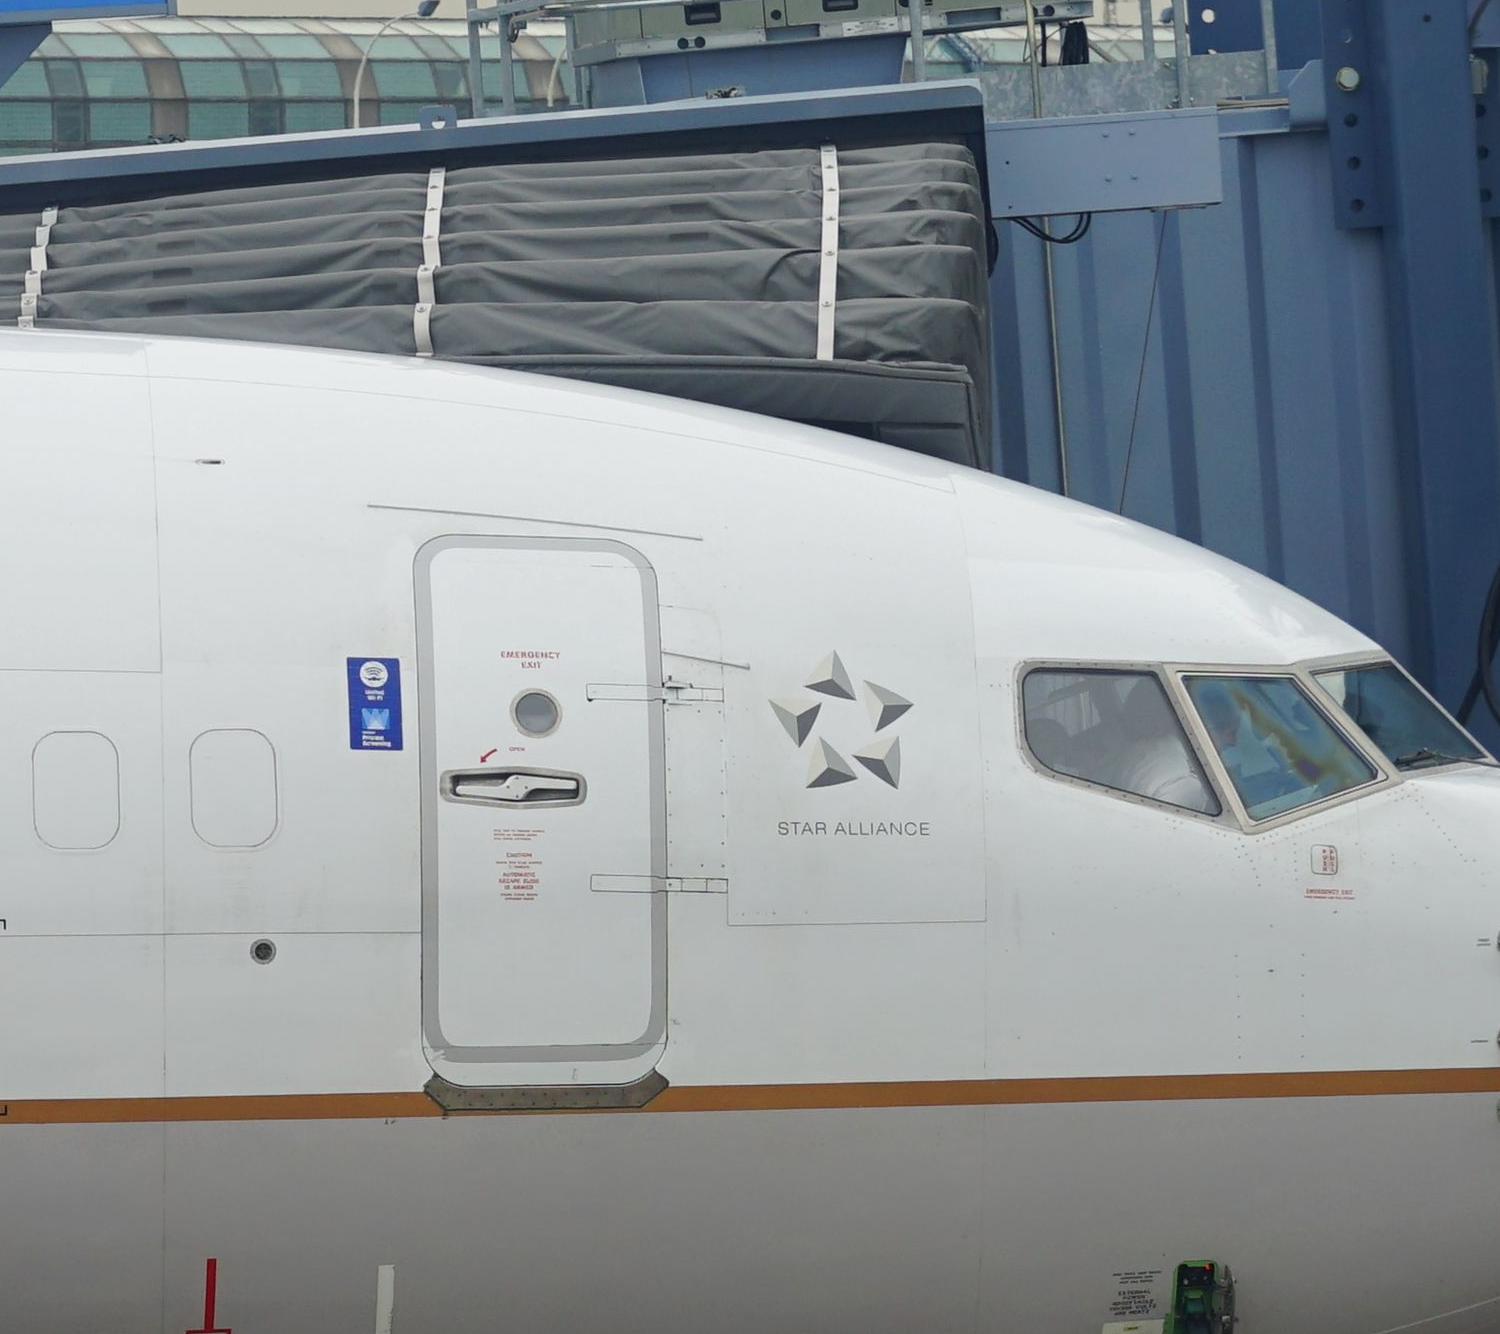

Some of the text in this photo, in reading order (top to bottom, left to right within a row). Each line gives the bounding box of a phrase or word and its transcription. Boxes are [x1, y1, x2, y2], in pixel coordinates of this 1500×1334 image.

[501, 651, 560, 659] EMERGENCY
[521, 661, 541, 669] EXIT
[777, 821, 930, 836] STAR ALLIANCE
